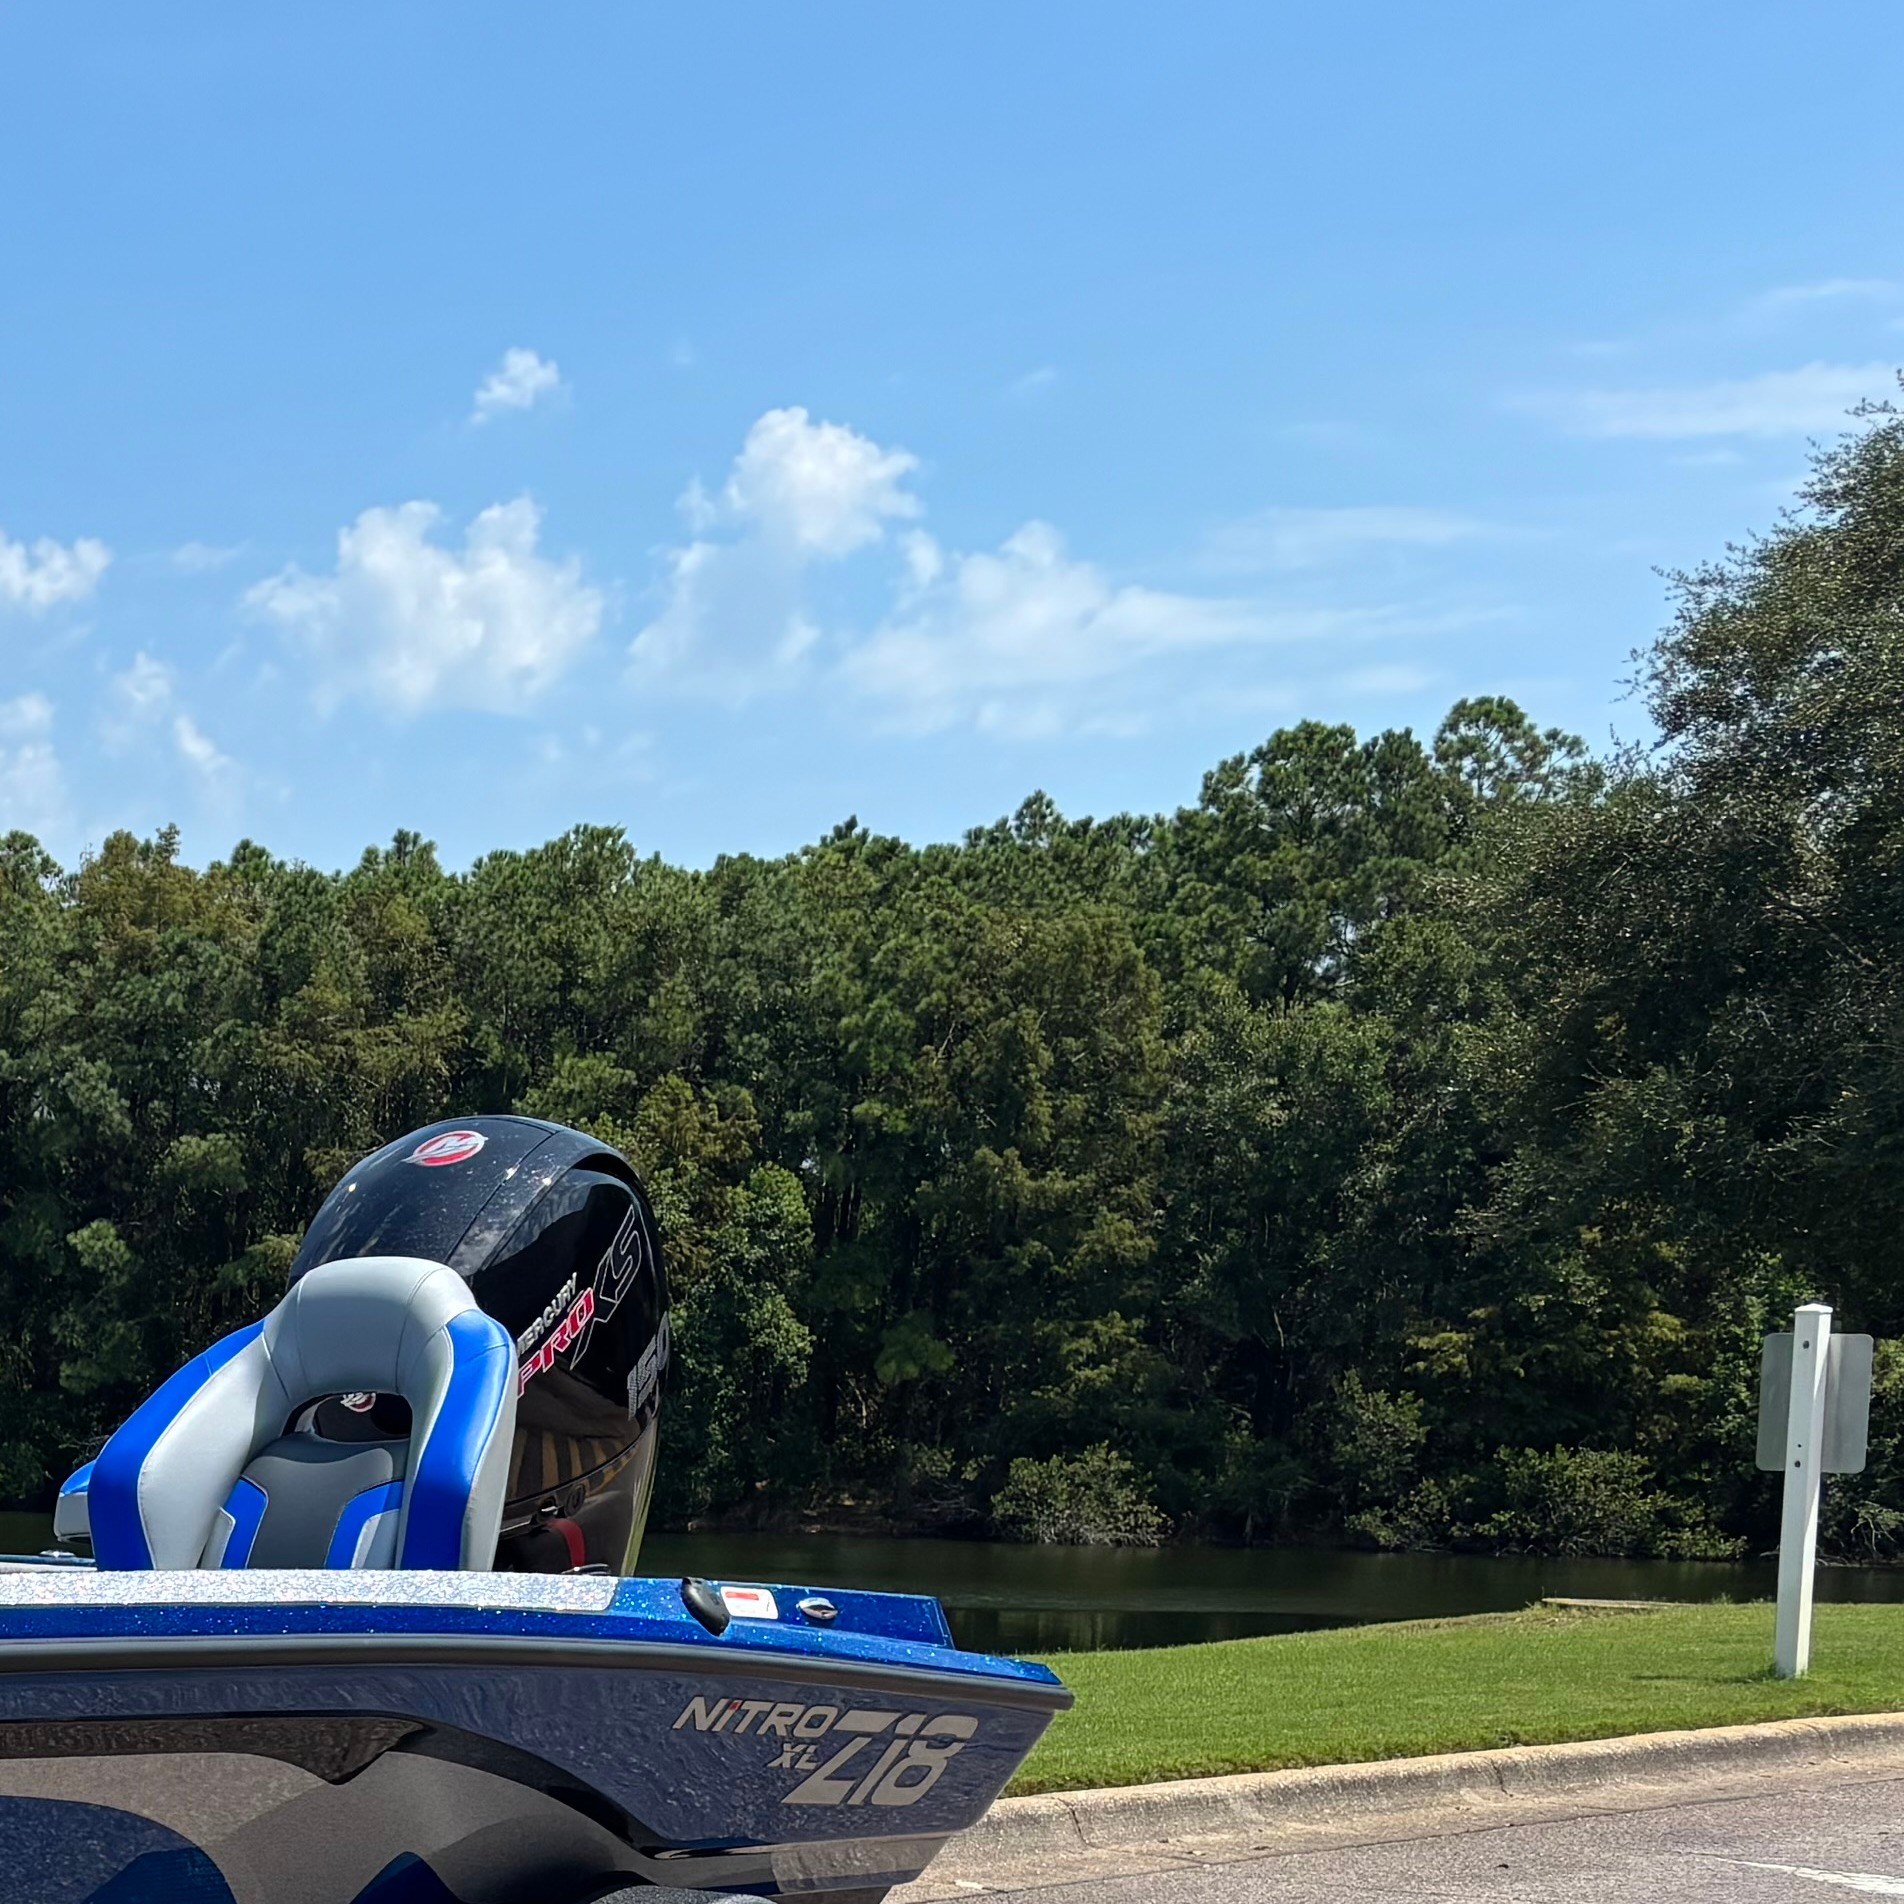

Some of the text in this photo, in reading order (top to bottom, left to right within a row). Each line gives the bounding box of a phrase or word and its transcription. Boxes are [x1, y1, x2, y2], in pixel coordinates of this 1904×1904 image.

[518, 1287, 594, 1398] PRO
[767, 1743, 819, 1770] XL
[780, 1709, 979, 1806] Z18
